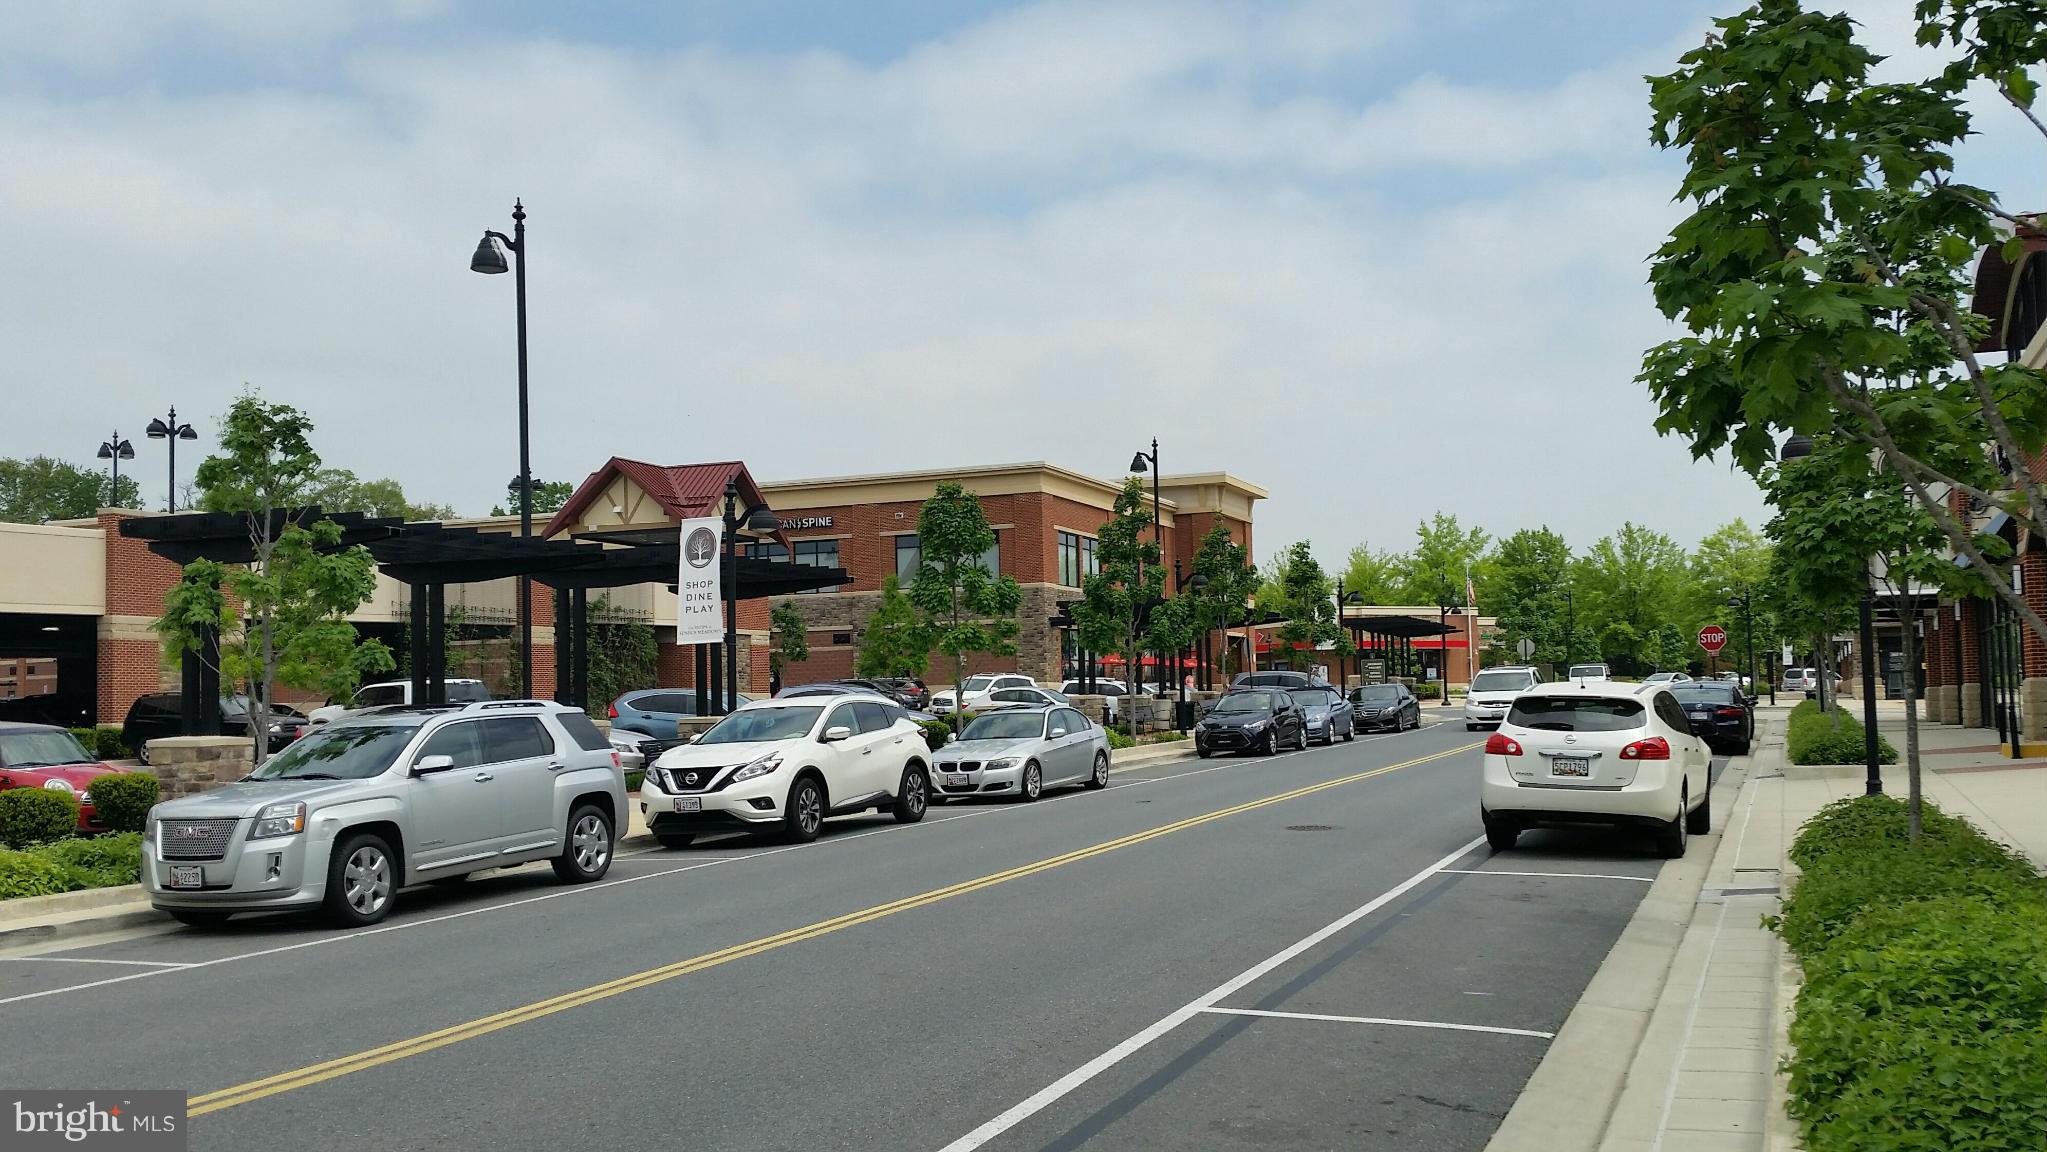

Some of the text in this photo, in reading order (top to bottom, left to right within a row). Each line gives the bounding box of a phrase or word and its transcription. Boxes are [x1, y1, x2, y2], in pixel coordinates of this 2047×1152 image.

[802, 516, 832, 528] SPINE
[685, 580, 714, 589] SHOP
[686, 592, 713, 602] DINE
[685, 604, 714, 614] PLAY
[1700, 633, 1724, 643] STOP
[174, 827, 210, 838] GMC
